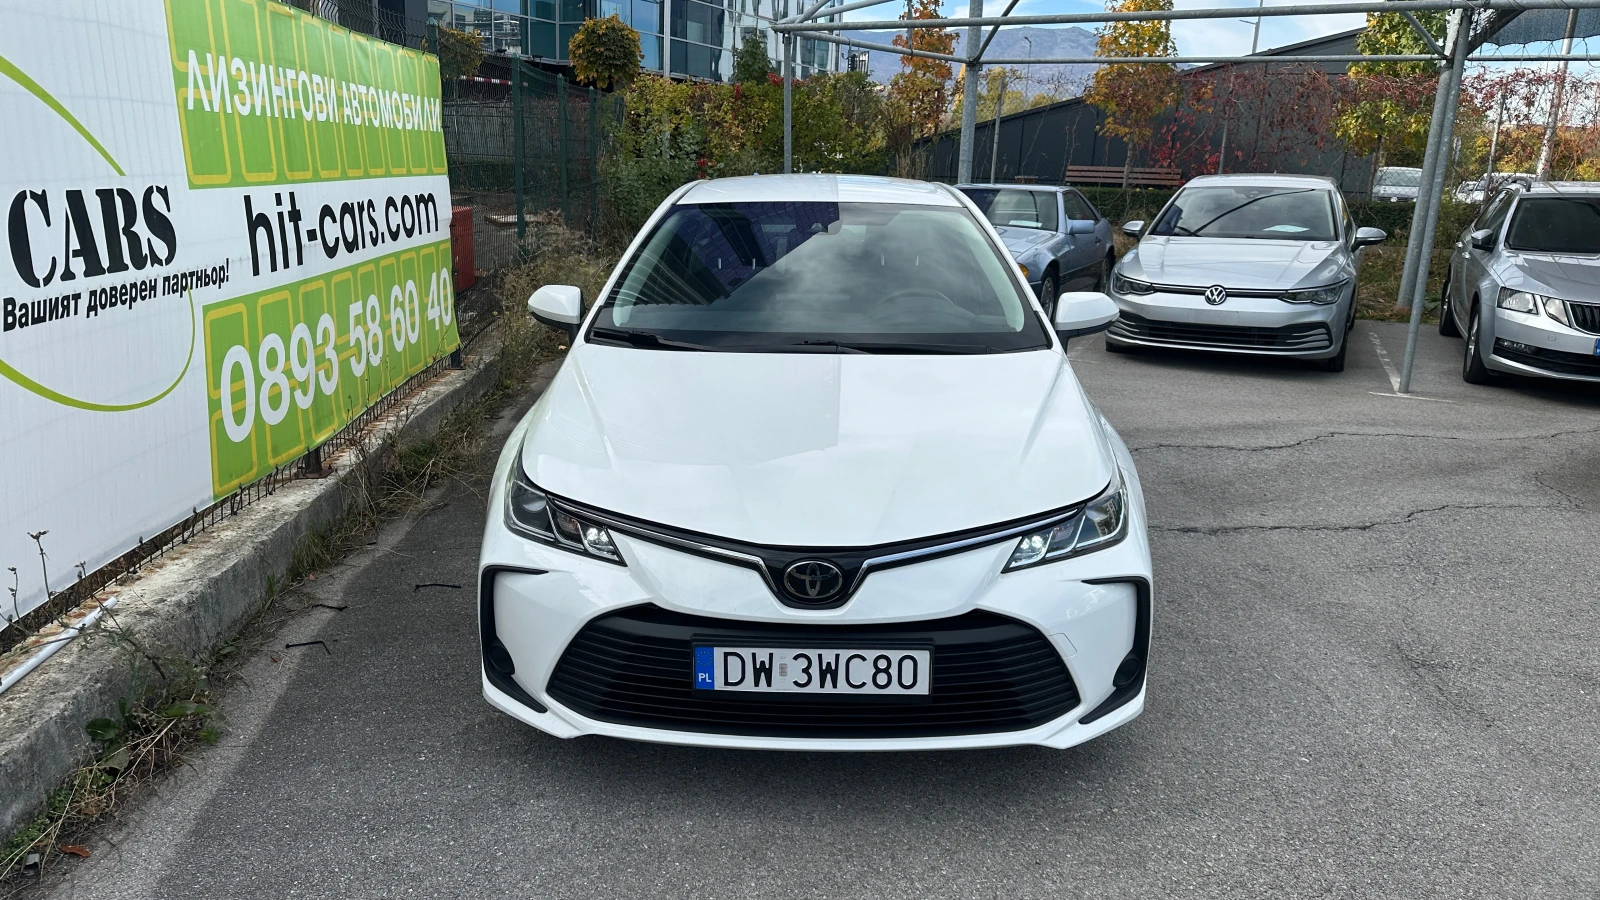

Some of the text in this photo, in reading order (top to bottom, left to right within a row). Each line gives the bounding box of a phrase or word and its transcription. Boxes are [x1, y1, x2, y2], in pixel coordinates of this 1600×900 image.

[187, 49, 442, 133] ЛИЗИНГОВИ АВТОМОБИЛИ
[8, 185, 177, 288] CARS
[243, 191, 439, 277] hit-cars.com
[3, 258, 229, 332] Вашият доверен партньор!
[220, 267, 452, 442] 0893 58 60 40
[698, 672, 712, 682] PL
[723, 651, 919, 690] DW 3WC80
